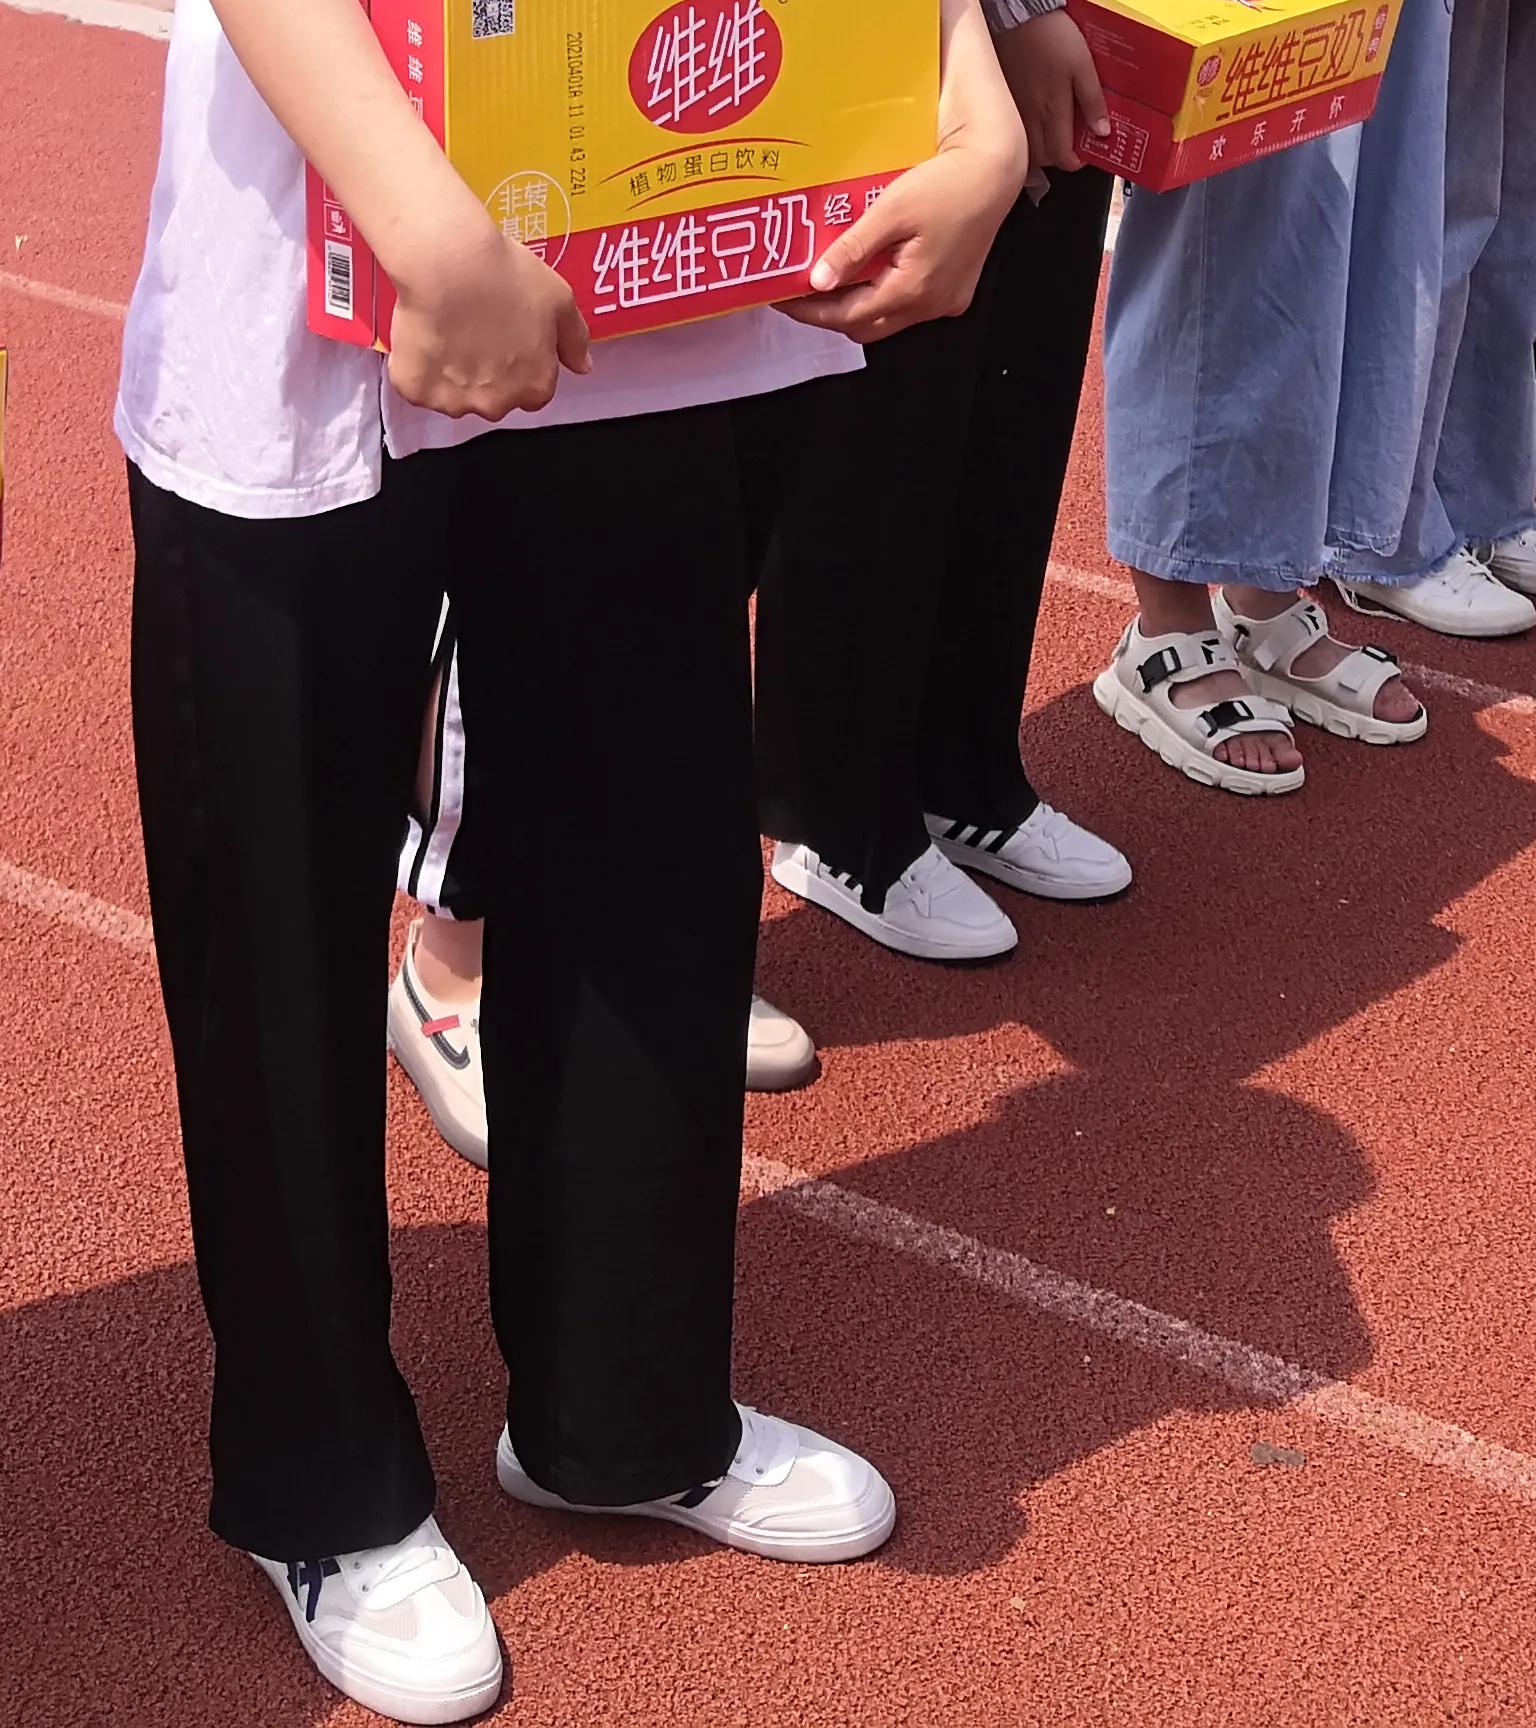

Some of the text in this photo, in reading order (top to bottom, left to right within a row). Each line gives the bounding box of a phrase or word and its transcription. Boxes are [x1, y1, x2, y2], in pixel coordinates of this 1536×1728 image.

[1215, 8, 1366, 122] 维维豆奶
[1209, 95, 1346, 161] 欢乐开怀
[498, 180, 549, 216] 非转
[629, 148, 781, 199] 植物蛋白饮料
[499, 210, 548, 243] 基因
[592, 193, 816, 315] 维维豆奶
